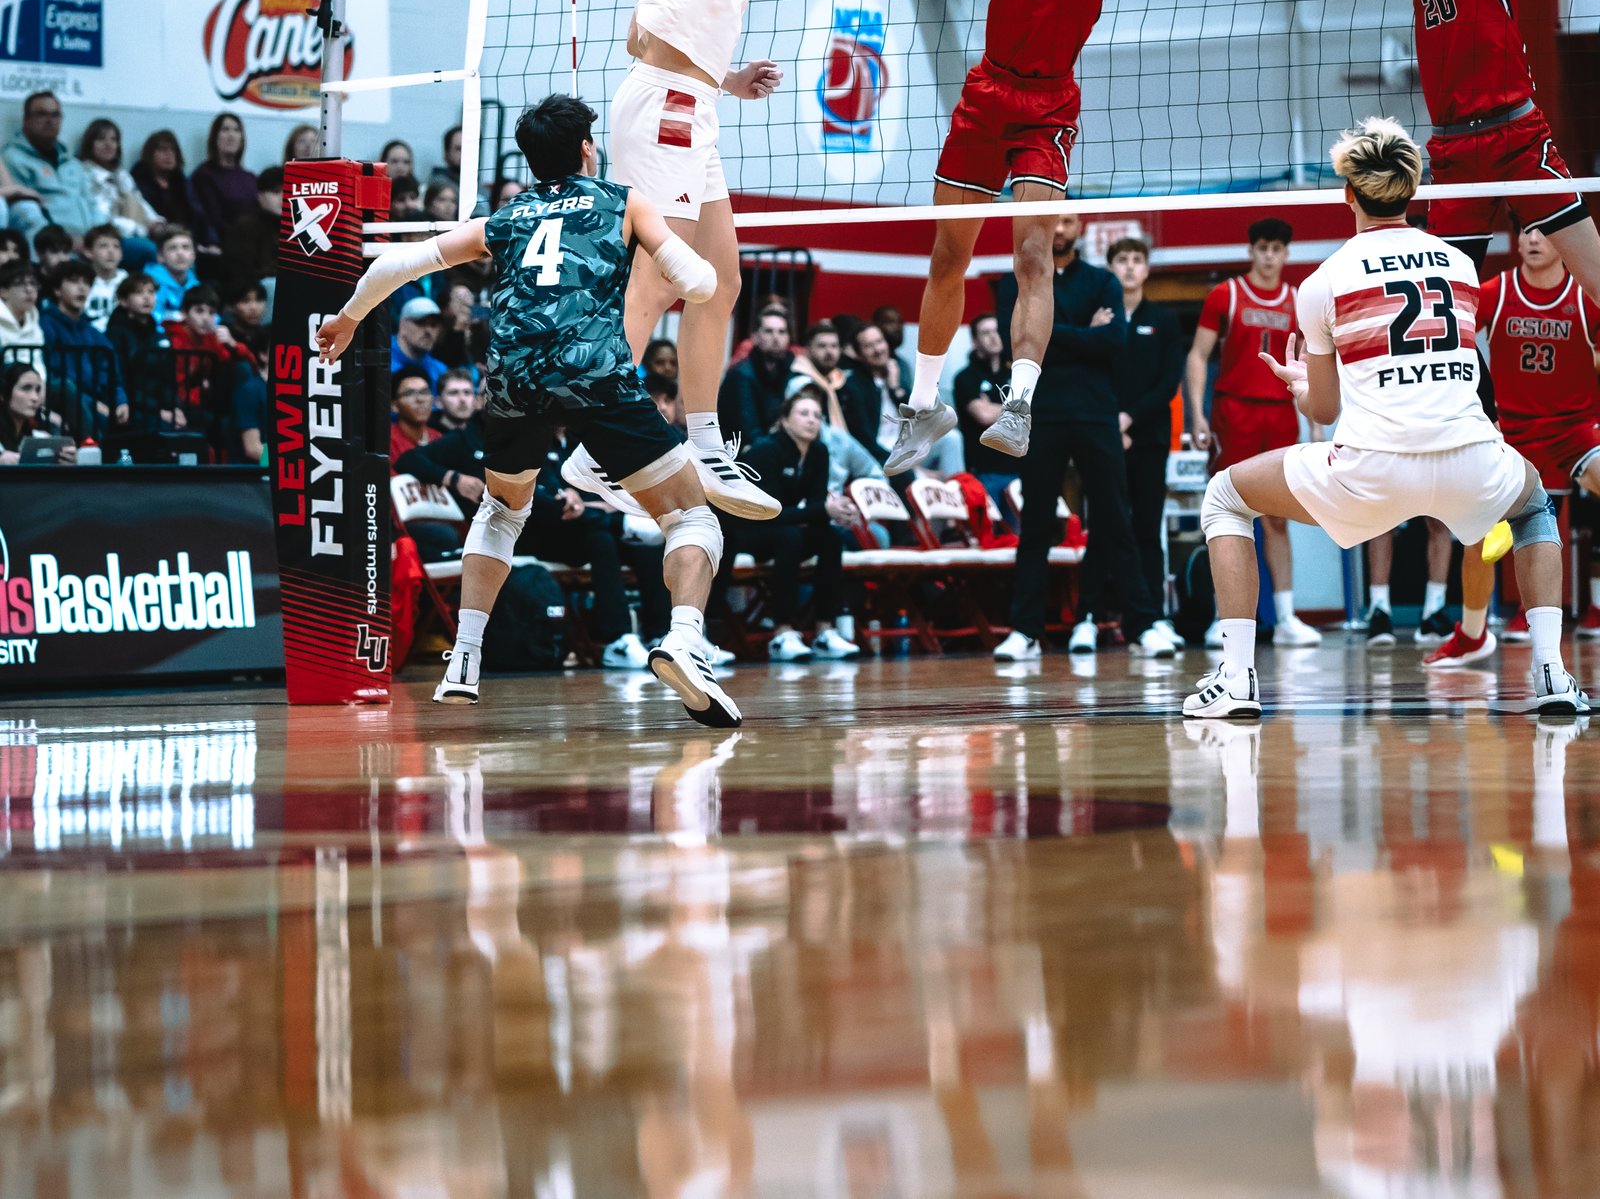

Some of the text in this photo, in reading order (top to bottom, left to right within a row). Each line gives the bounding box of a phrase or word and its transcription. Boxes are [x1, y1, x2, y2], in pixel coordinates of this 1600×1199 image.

[45, 3, 99, 32] Express
[292, 181, 339, 196] LEWIS
[509, 195, 595, 220] FLYERS
[521, 217, 564, 287] 4
[1361, 251, 1450, 275] LEWIS
[1384, 276, 1460, 356] 23
[1506, 316, 1573, 340] CSUN
[1520, 342, 1556, 373] 23
[1377, 362, 1474, 388] FLYERS
[275, 343, 306, 528] LEWIS
[365, 483, 378, 615] sports imports
